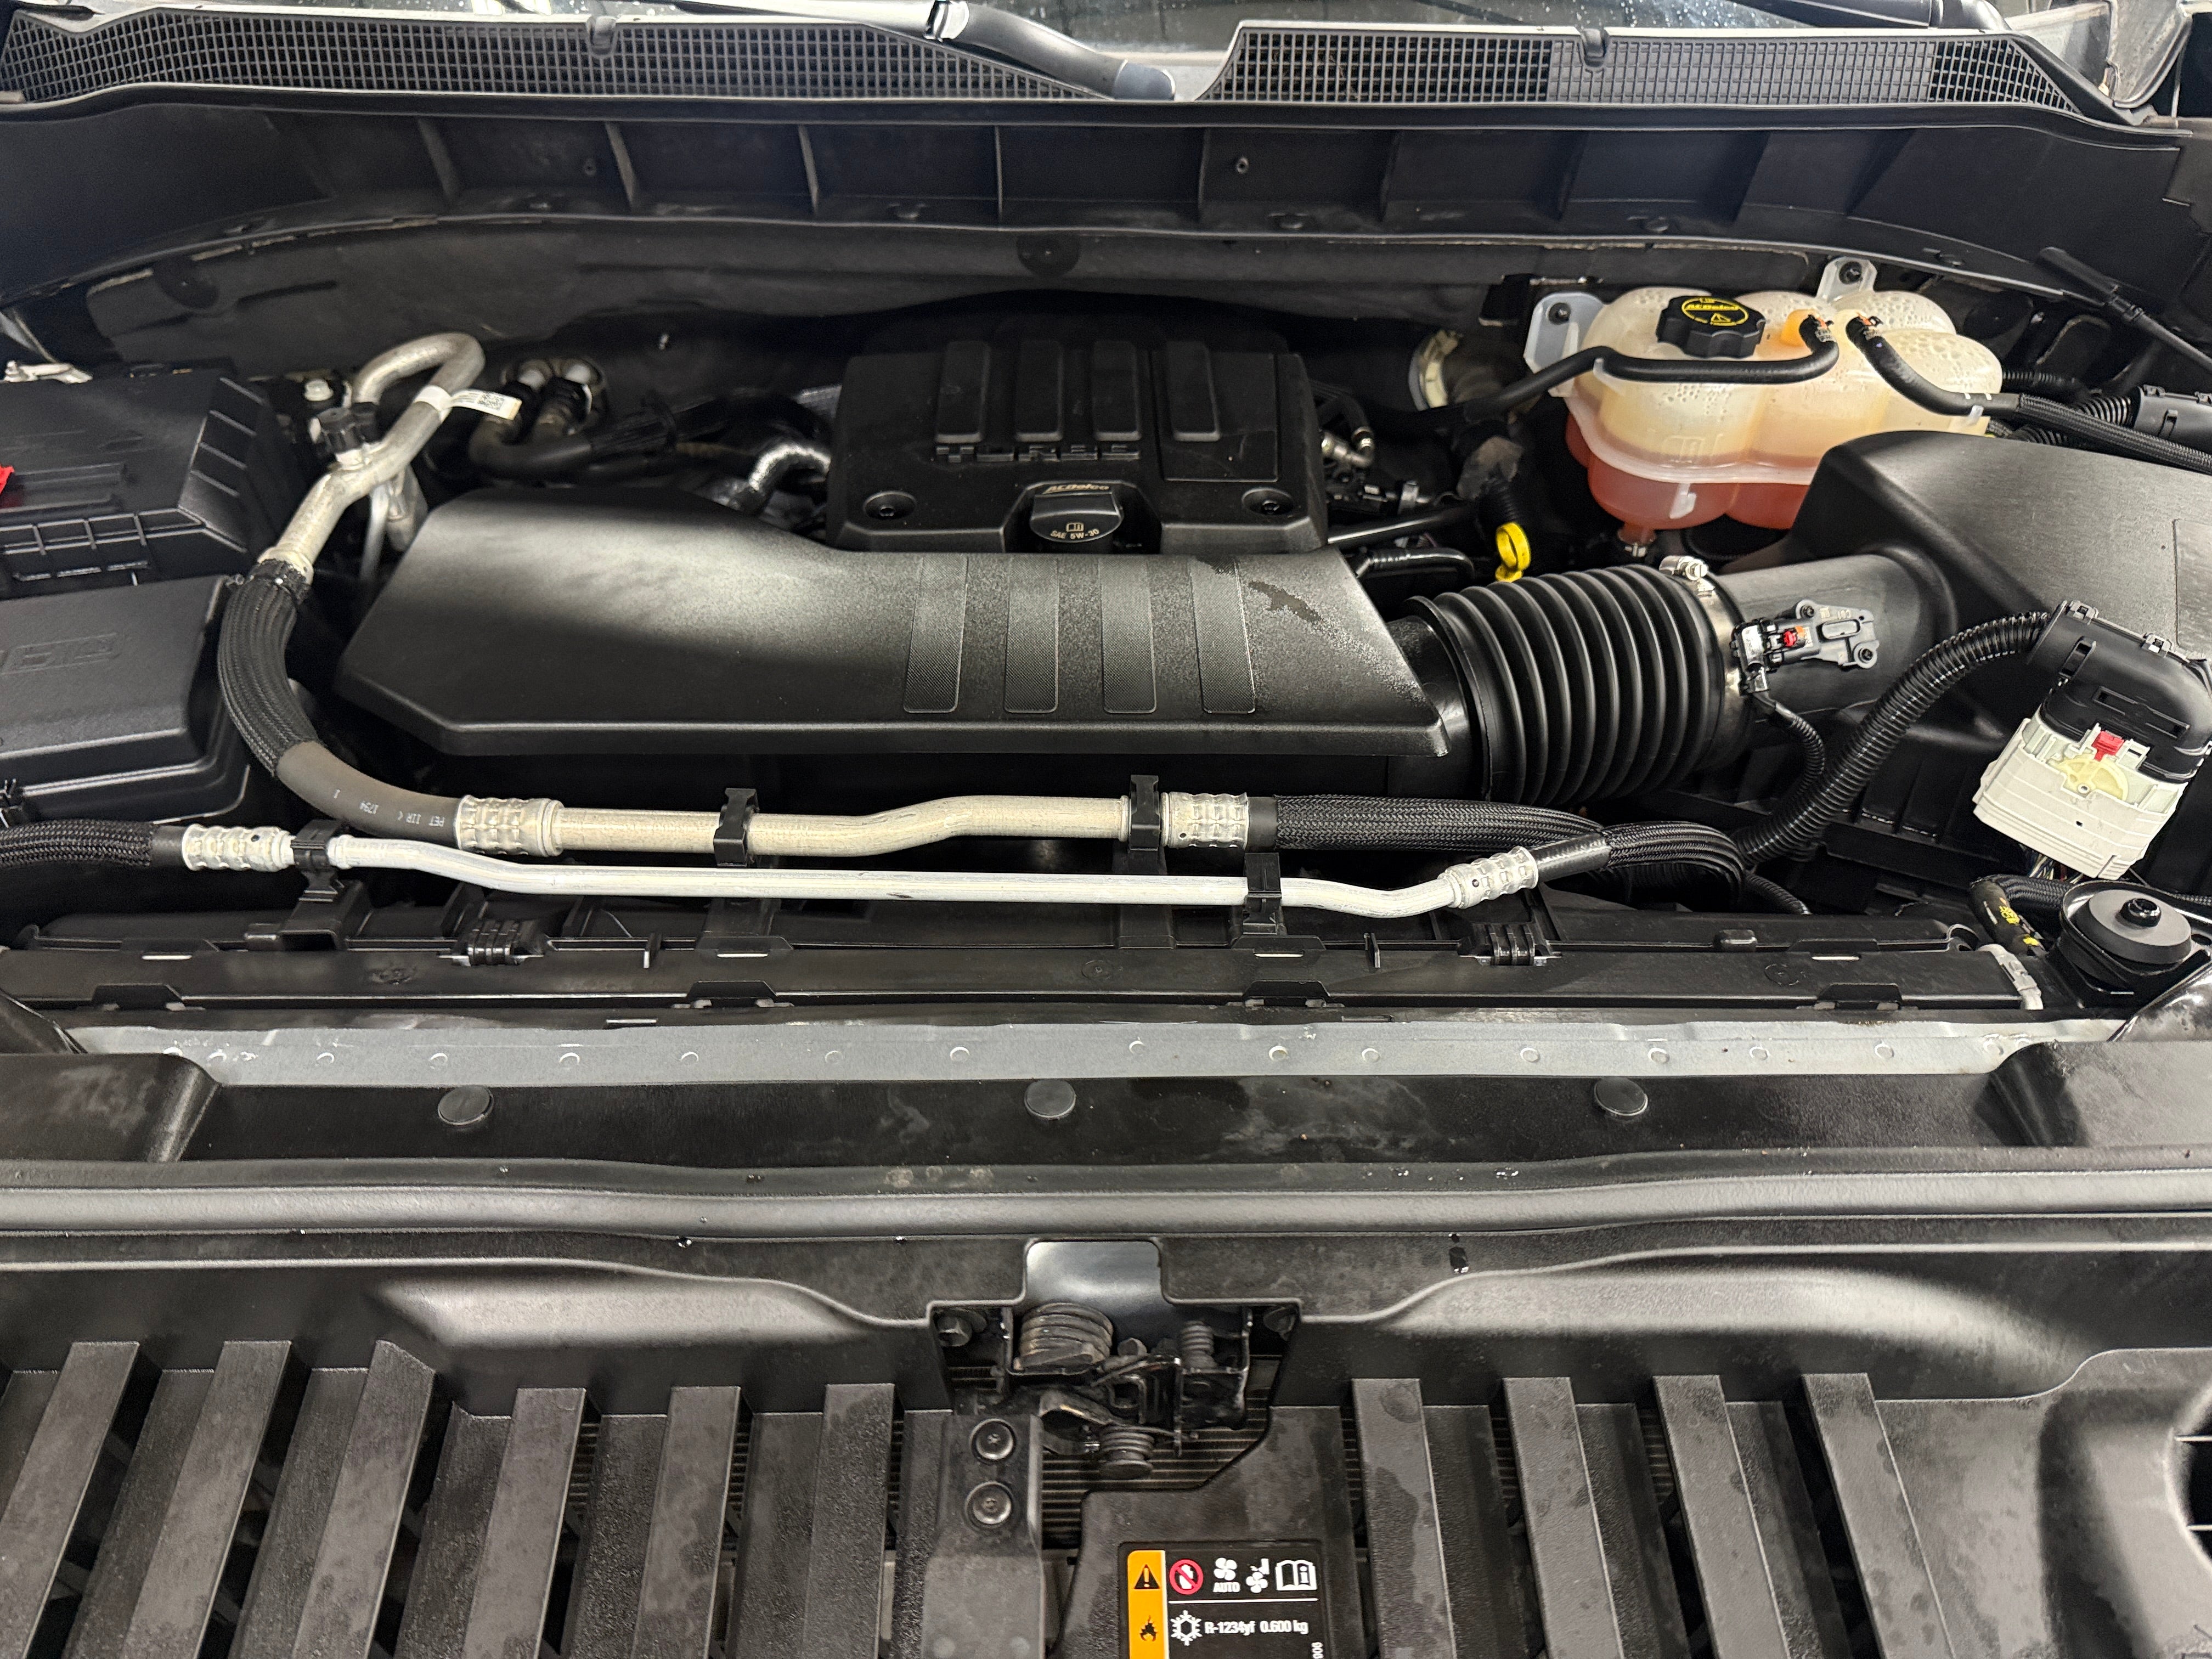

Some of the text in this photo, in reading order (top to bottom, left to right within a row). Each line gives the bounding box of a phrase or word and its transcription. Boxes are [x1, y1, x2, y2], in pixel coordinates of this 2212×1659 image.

[1043, 483, 1109, 494] ACDelco
[1050, 529, 1100, 540] SAE 5W-30
[428, 816, 445, 827] PET
[1212, 1582, 1240, 1593] AUTO
[1205, 1620, 1309, 1636] R-1234yf 0.600 kg
